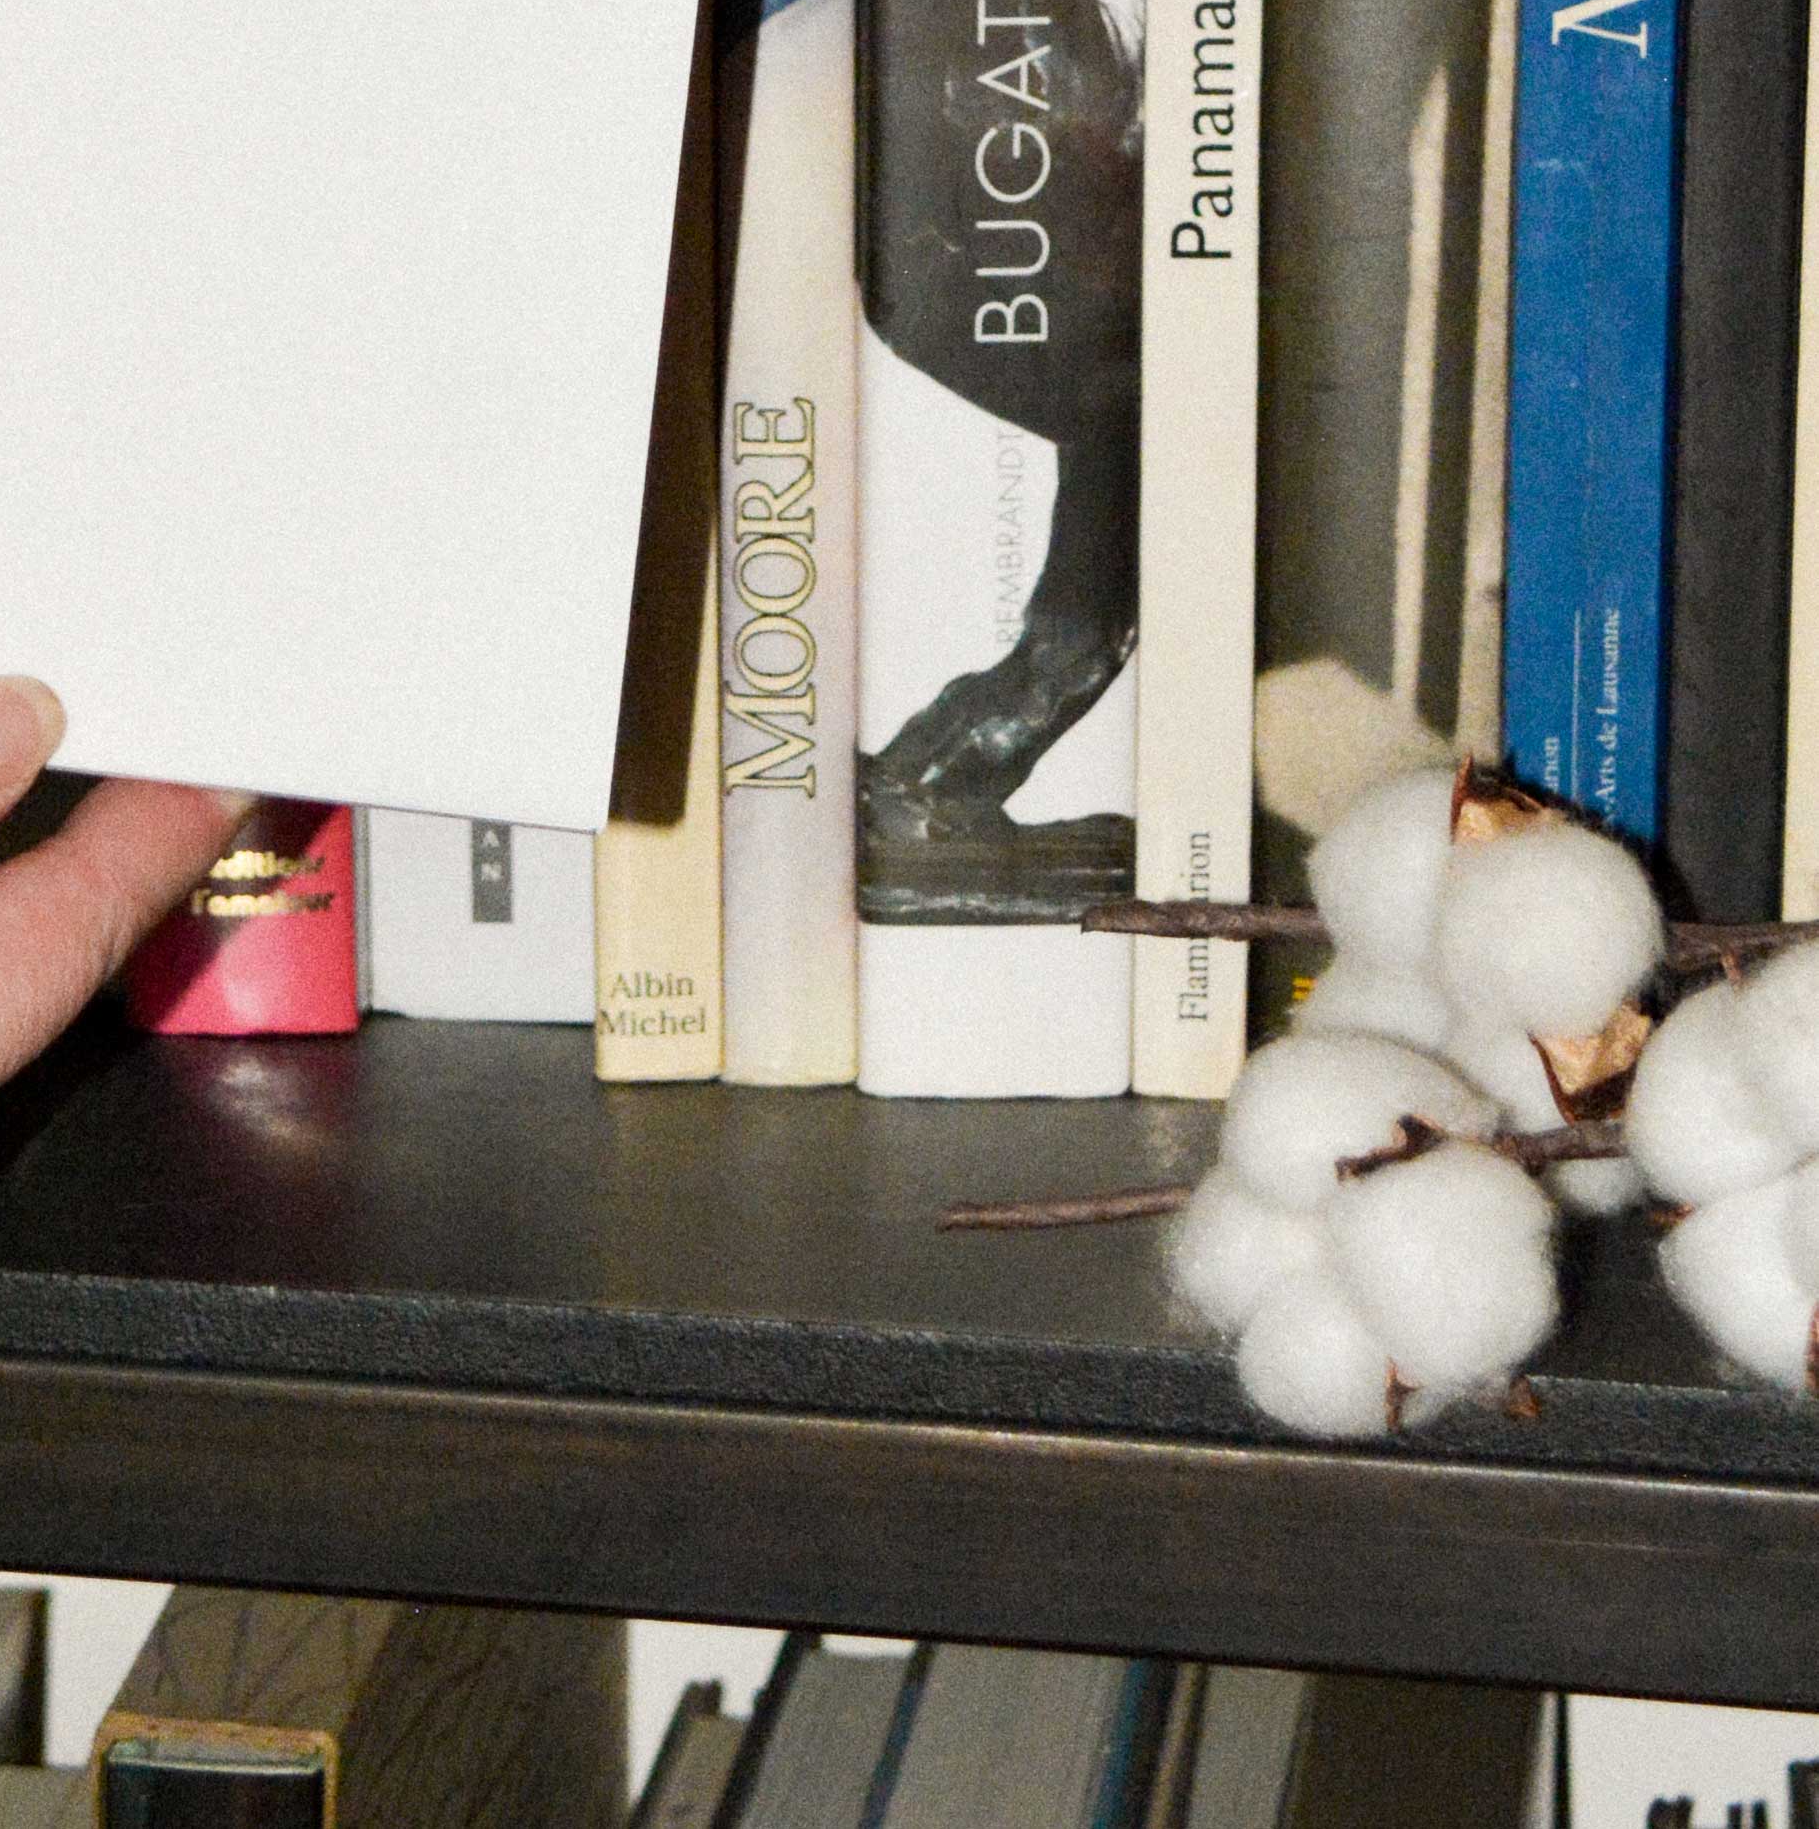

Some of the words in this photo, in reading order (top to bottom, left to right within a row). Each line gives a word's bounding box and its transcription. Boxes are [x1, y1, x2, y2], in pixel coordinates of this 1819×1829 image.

[724, 396, 817, 799] MOORE
[993, 430, 1027, 645] REMBRANDT
[597, 1006, 707, 1037] Michel
[610, 971, 696, 1000] Albin
[1178, 831, 1211, 1022] Flamrion
